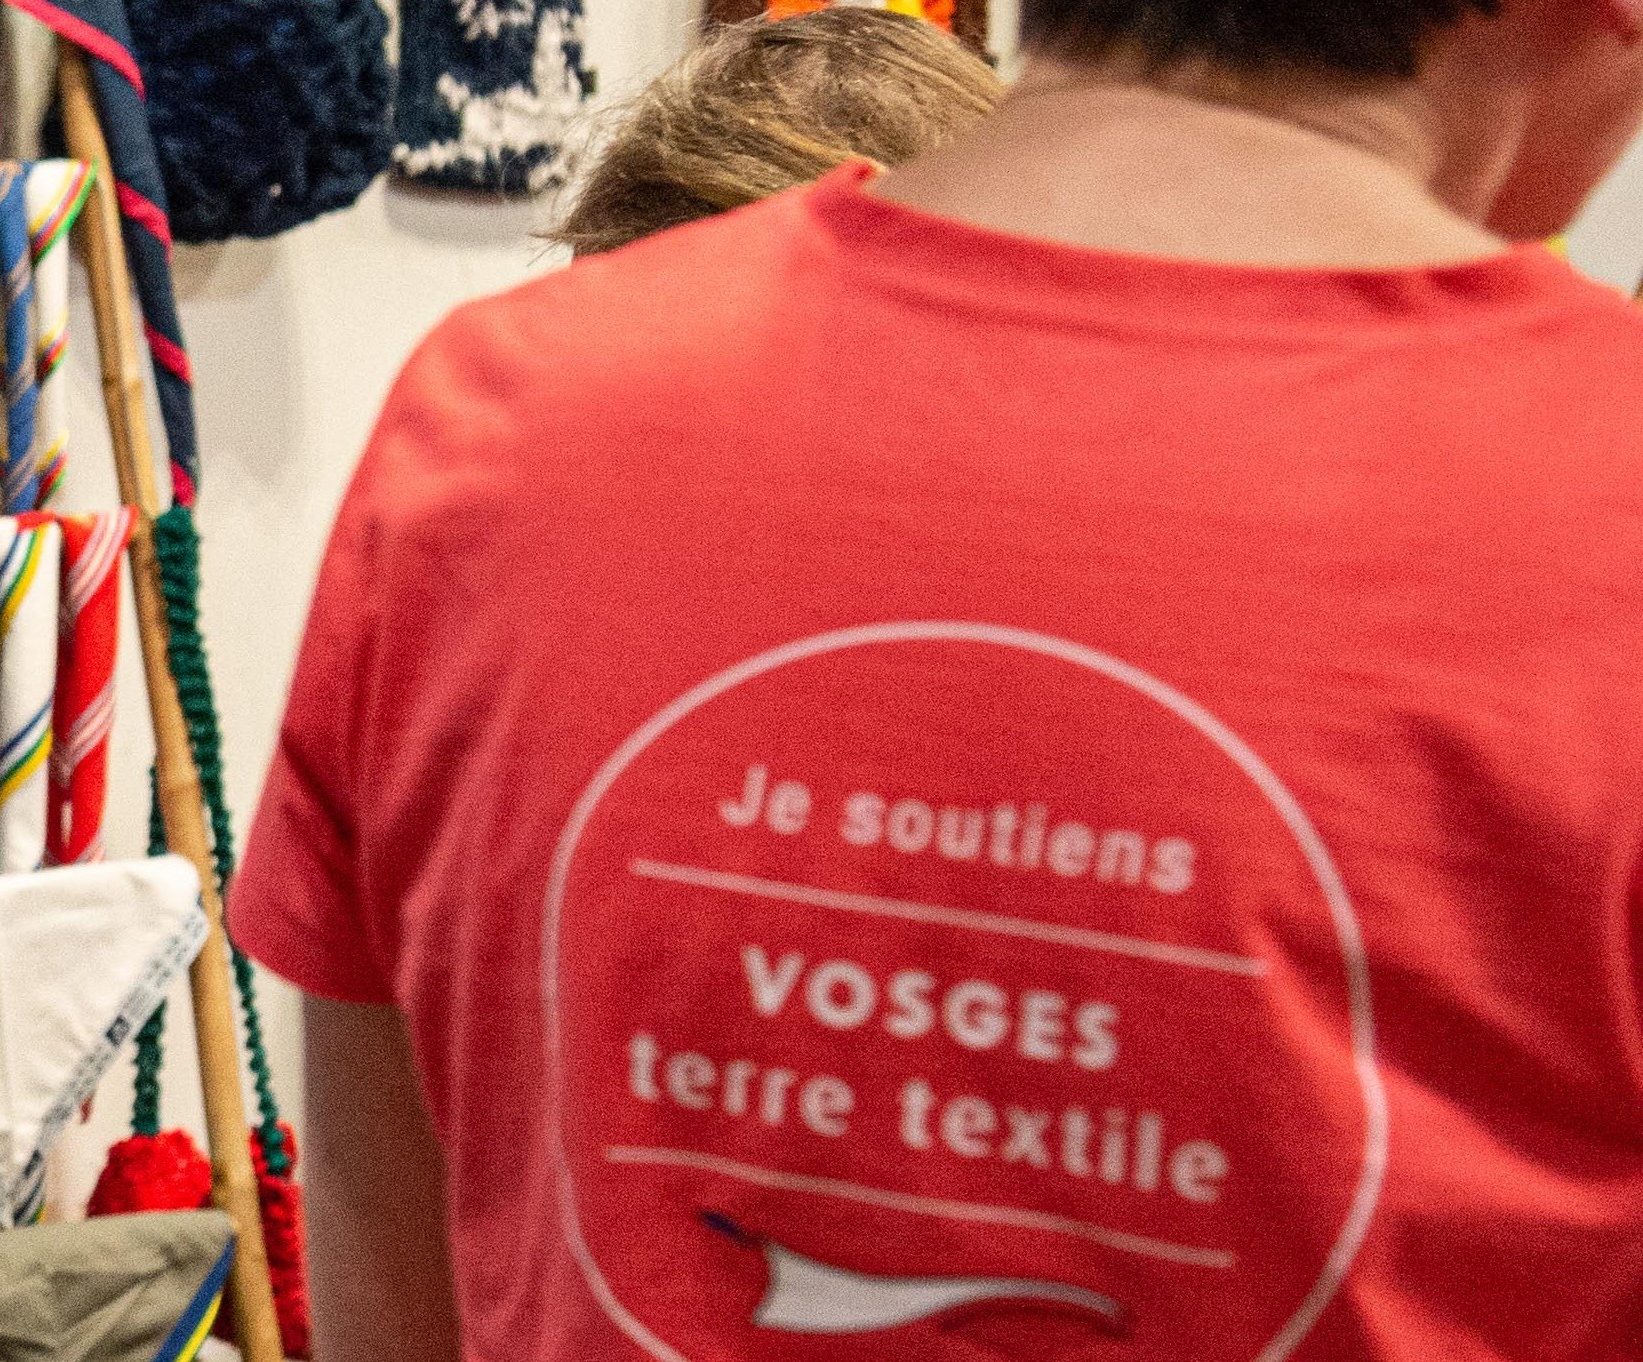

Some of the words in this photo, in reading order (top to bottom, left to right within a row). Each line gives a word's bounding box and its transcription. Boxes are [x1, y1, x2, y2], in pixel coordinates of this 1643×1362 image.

[719, 765, 811, 835] Je
[841, 792, 1196, 896] soutiens
[742, 945, 1119, 1071] VOSGES
[627, 1032, 854, 1137] terre
[899, 1079, 1229, 1204] textile
